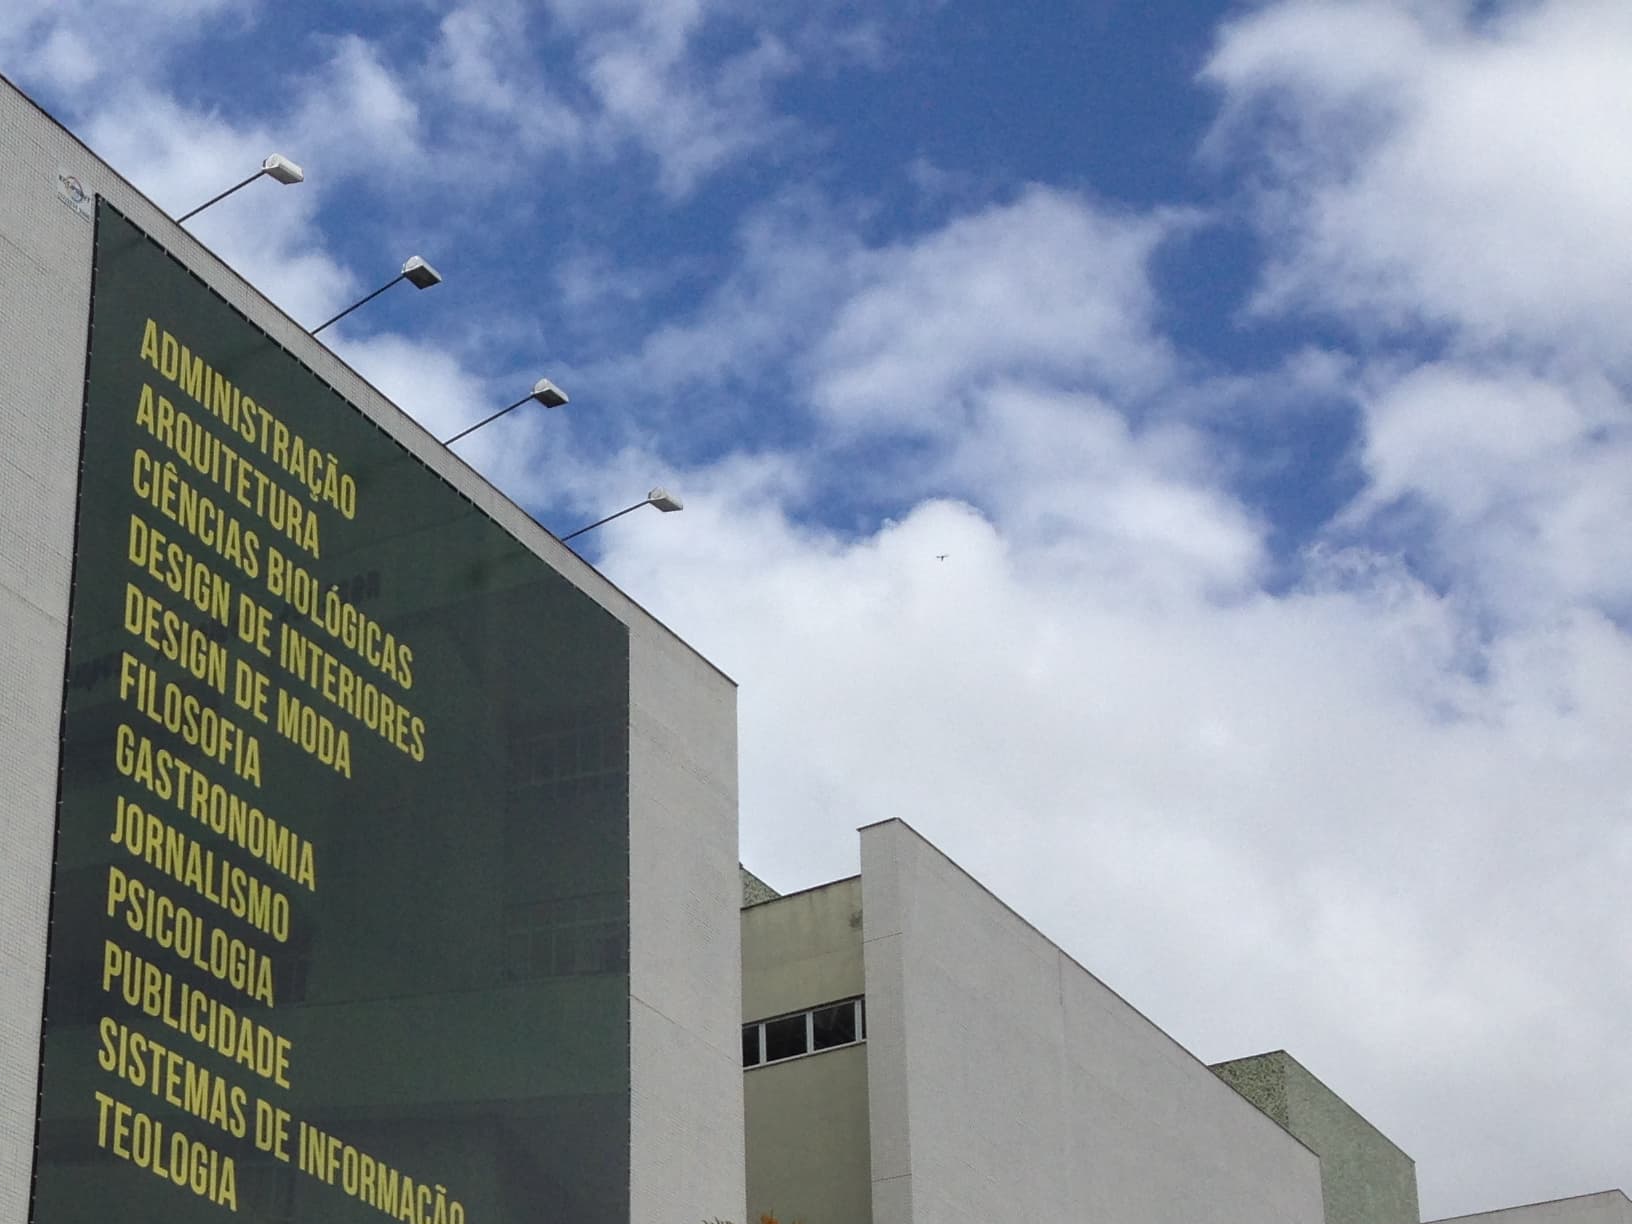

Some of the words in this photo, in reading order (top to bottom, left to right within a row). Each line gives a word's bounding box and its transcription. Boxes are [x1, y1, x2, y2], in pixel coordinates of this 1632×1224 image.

[136, 383, 319, 559] ARQUITETURA
[140, 318, 356, 520] ADMINISTRAÇÃO
[129, 514, 230, 626] DESIGN
[238, 592, 272, 657] DE
[281, 623, 425, 762] INTERIORES
[133, 448, 259, 579] CIÊNCIAS
[267, 546, 413, 689] BIOLÓGICAS
[120, 652, 261, 788] FILOSOFIA
[125, 582, 226, 694] DESIGN
[235, 658, 269, 723] DE
[277, 688, 351, 778] MODA
[111, 795, 289, 943] JORNALISMO
[116, 723, 315, 891] GASTRONOMIA
[103, 940, 290, 1089] PUBLICIDADE
[108, 866, 273, 1008] PSICOLOGIA
[95, 1091, 237, 1212] TEOLOGIA
[98, 1017, 246, 1139] SISTEMAS
[256, 1098, 290, 1162] DE
